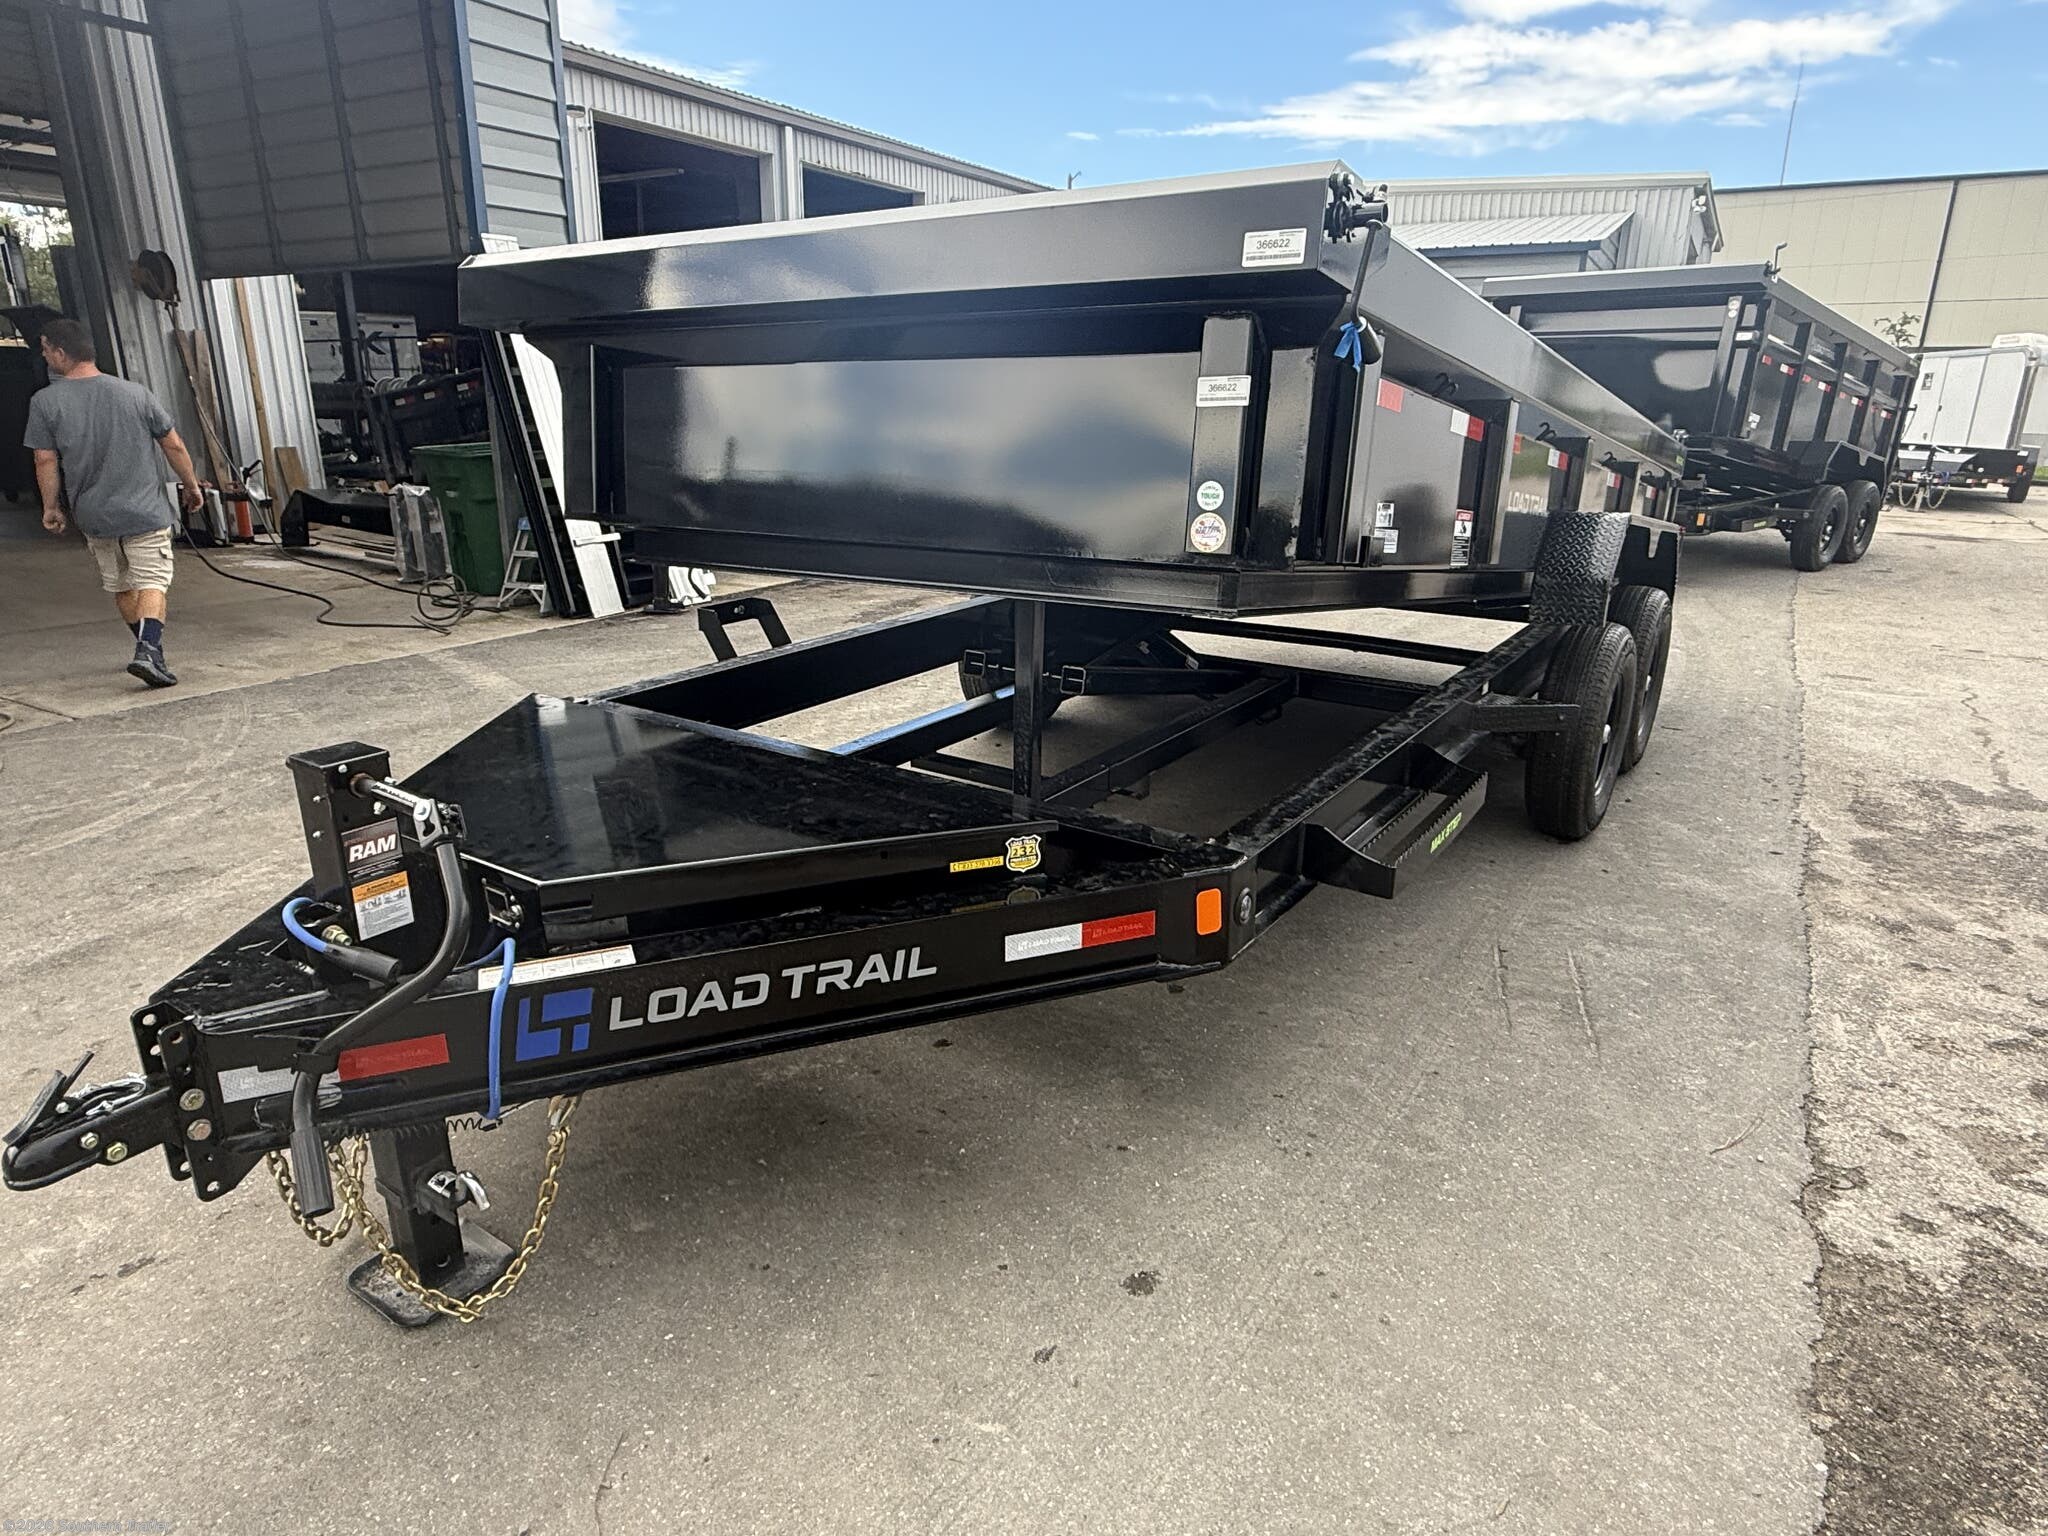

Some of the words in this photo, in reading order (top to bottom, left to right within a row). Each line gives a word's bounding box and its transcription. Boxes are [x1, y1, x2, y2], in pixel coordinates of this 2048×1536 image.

[1256, 238, 1291, 250] 366622
[349, 834, 396, 862] RAM
[1012, 846, 1035, 856] 232
[609, 973, 770, 1031] LOAD
[781, 946, 937, 999] TRAIL
